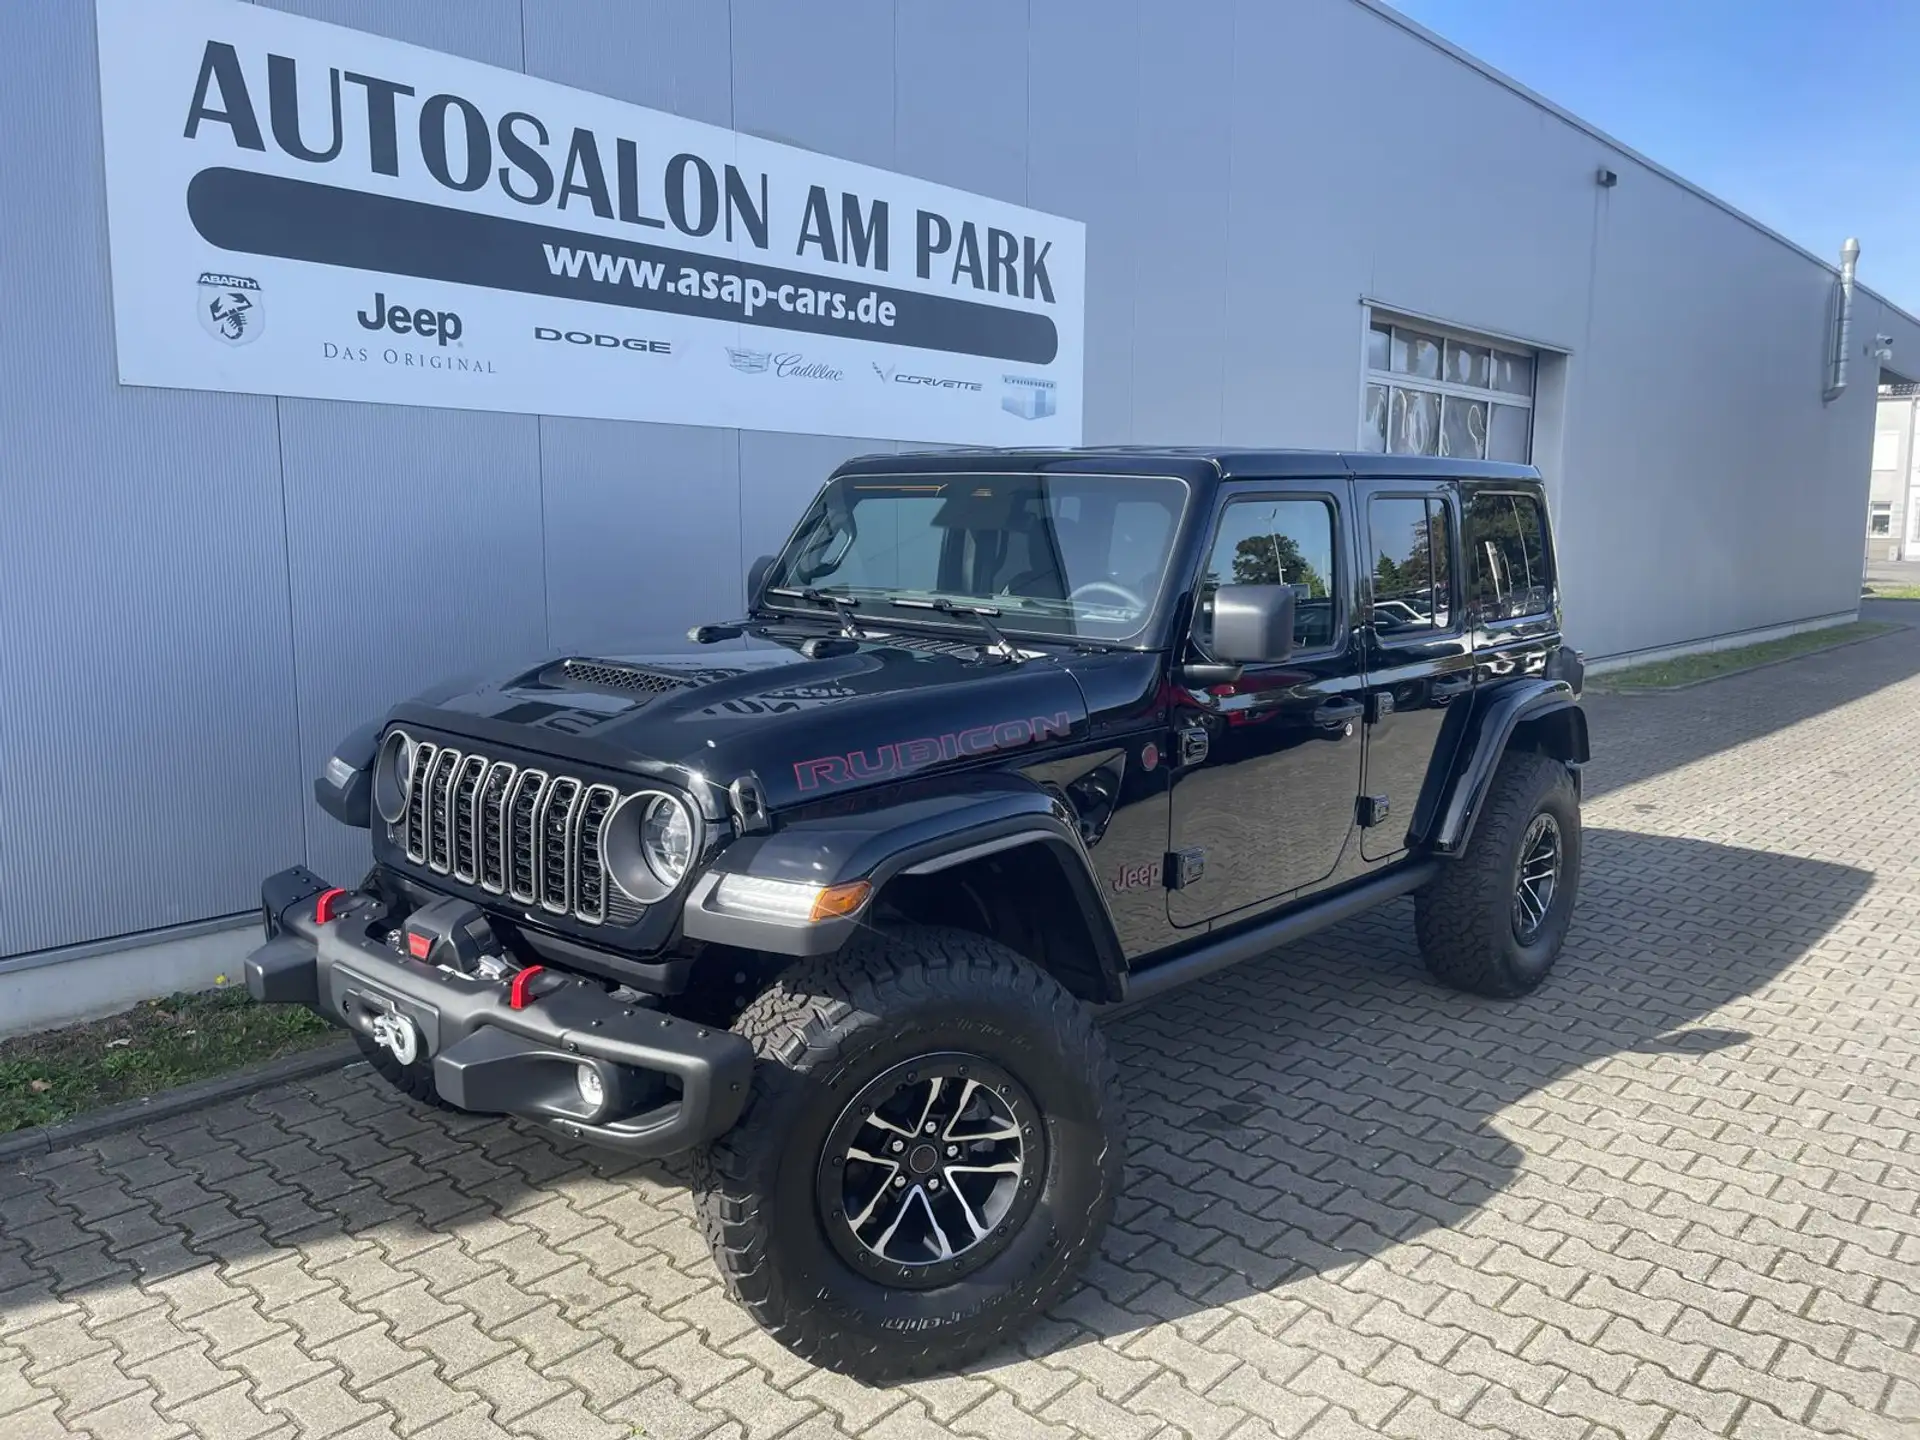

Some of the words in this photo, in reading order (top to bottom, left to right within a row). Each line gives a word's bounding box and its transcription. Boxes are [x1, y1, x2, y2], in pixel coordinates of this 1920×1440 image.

[183, 40, 769, 250] AUTOSALON
[796, 184, 889, 272] AM
[916, 208, 1057, 304] PARK
[200, 274, 258, 290] ABARTH
[542, 243, 897, 327] www.asap-cars.de
[357, 292, 463, 347] Jeep
[534, 327, 672, 354] DODGE
[383, 349, 498, 374] ORIGINAL
[773, 352, 844, 382] Cadillac
[894, 374, 983, 392] CORVETTE
[793, 711, 1071, 791] RUBICON
[1112, 862, 1159, 892] Jeep
